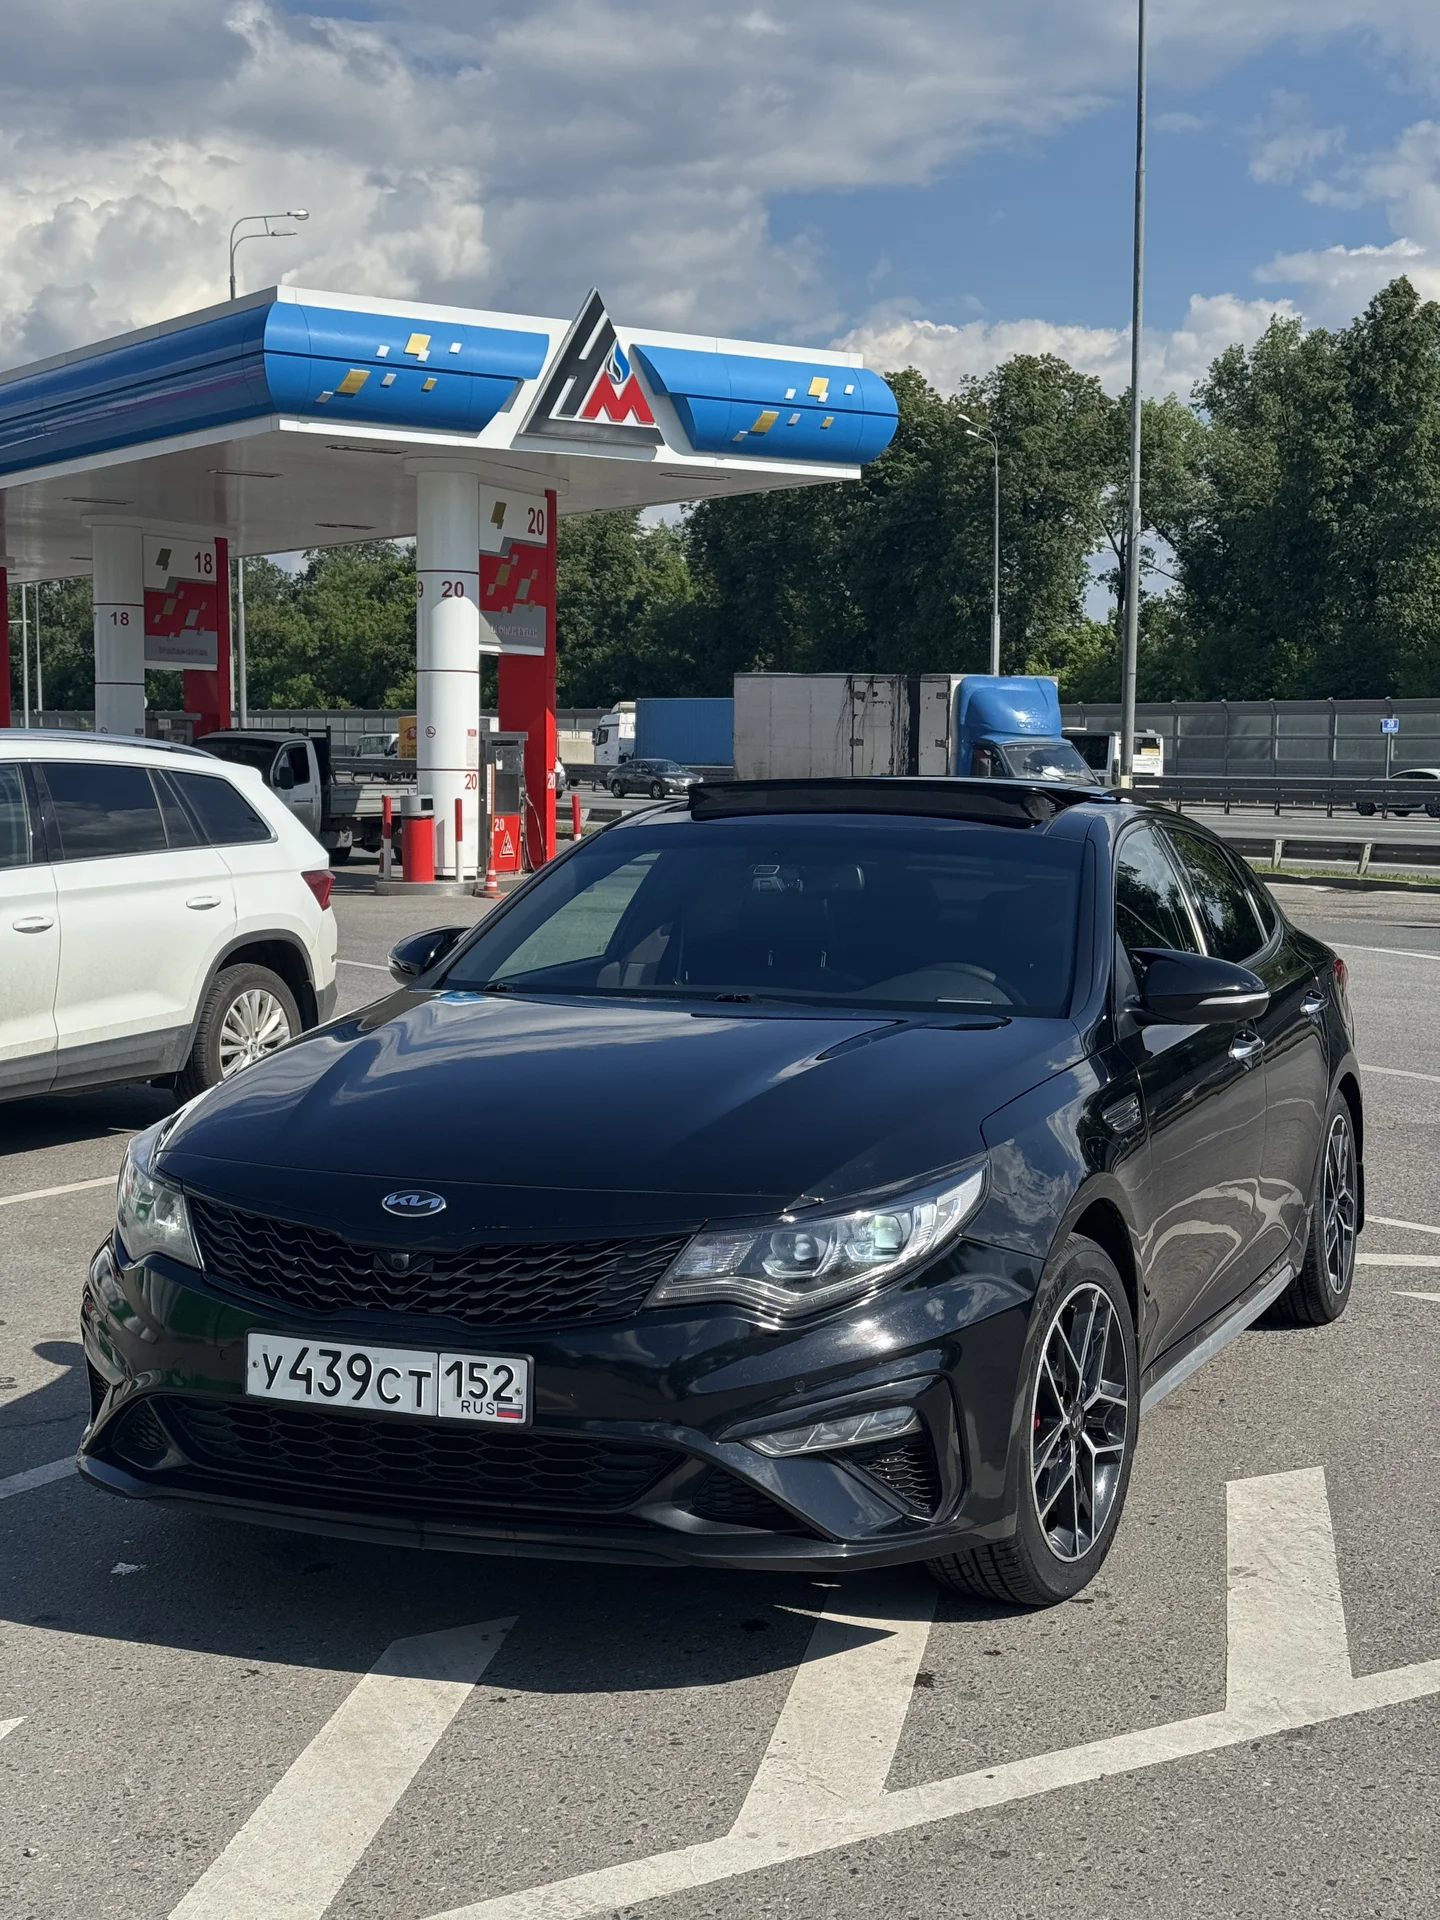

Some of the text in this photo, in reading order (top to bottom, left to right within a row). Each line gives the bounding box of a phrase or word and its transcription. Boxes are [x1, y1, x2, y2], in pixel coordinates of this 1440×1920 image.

[528, 507, 545, 536] 20
[195, 551, 212, 575] 18
[441, 580, 464, 598] 20
[110, 612, 129, 626] 18
[465, 774, 477, 790] 20
[547, 773, 555, 789] 20
[495, 819, 504, 831] 20
[444, 1360, 515, 1402] 152
[461, 1400, 495, 1415] RUS
